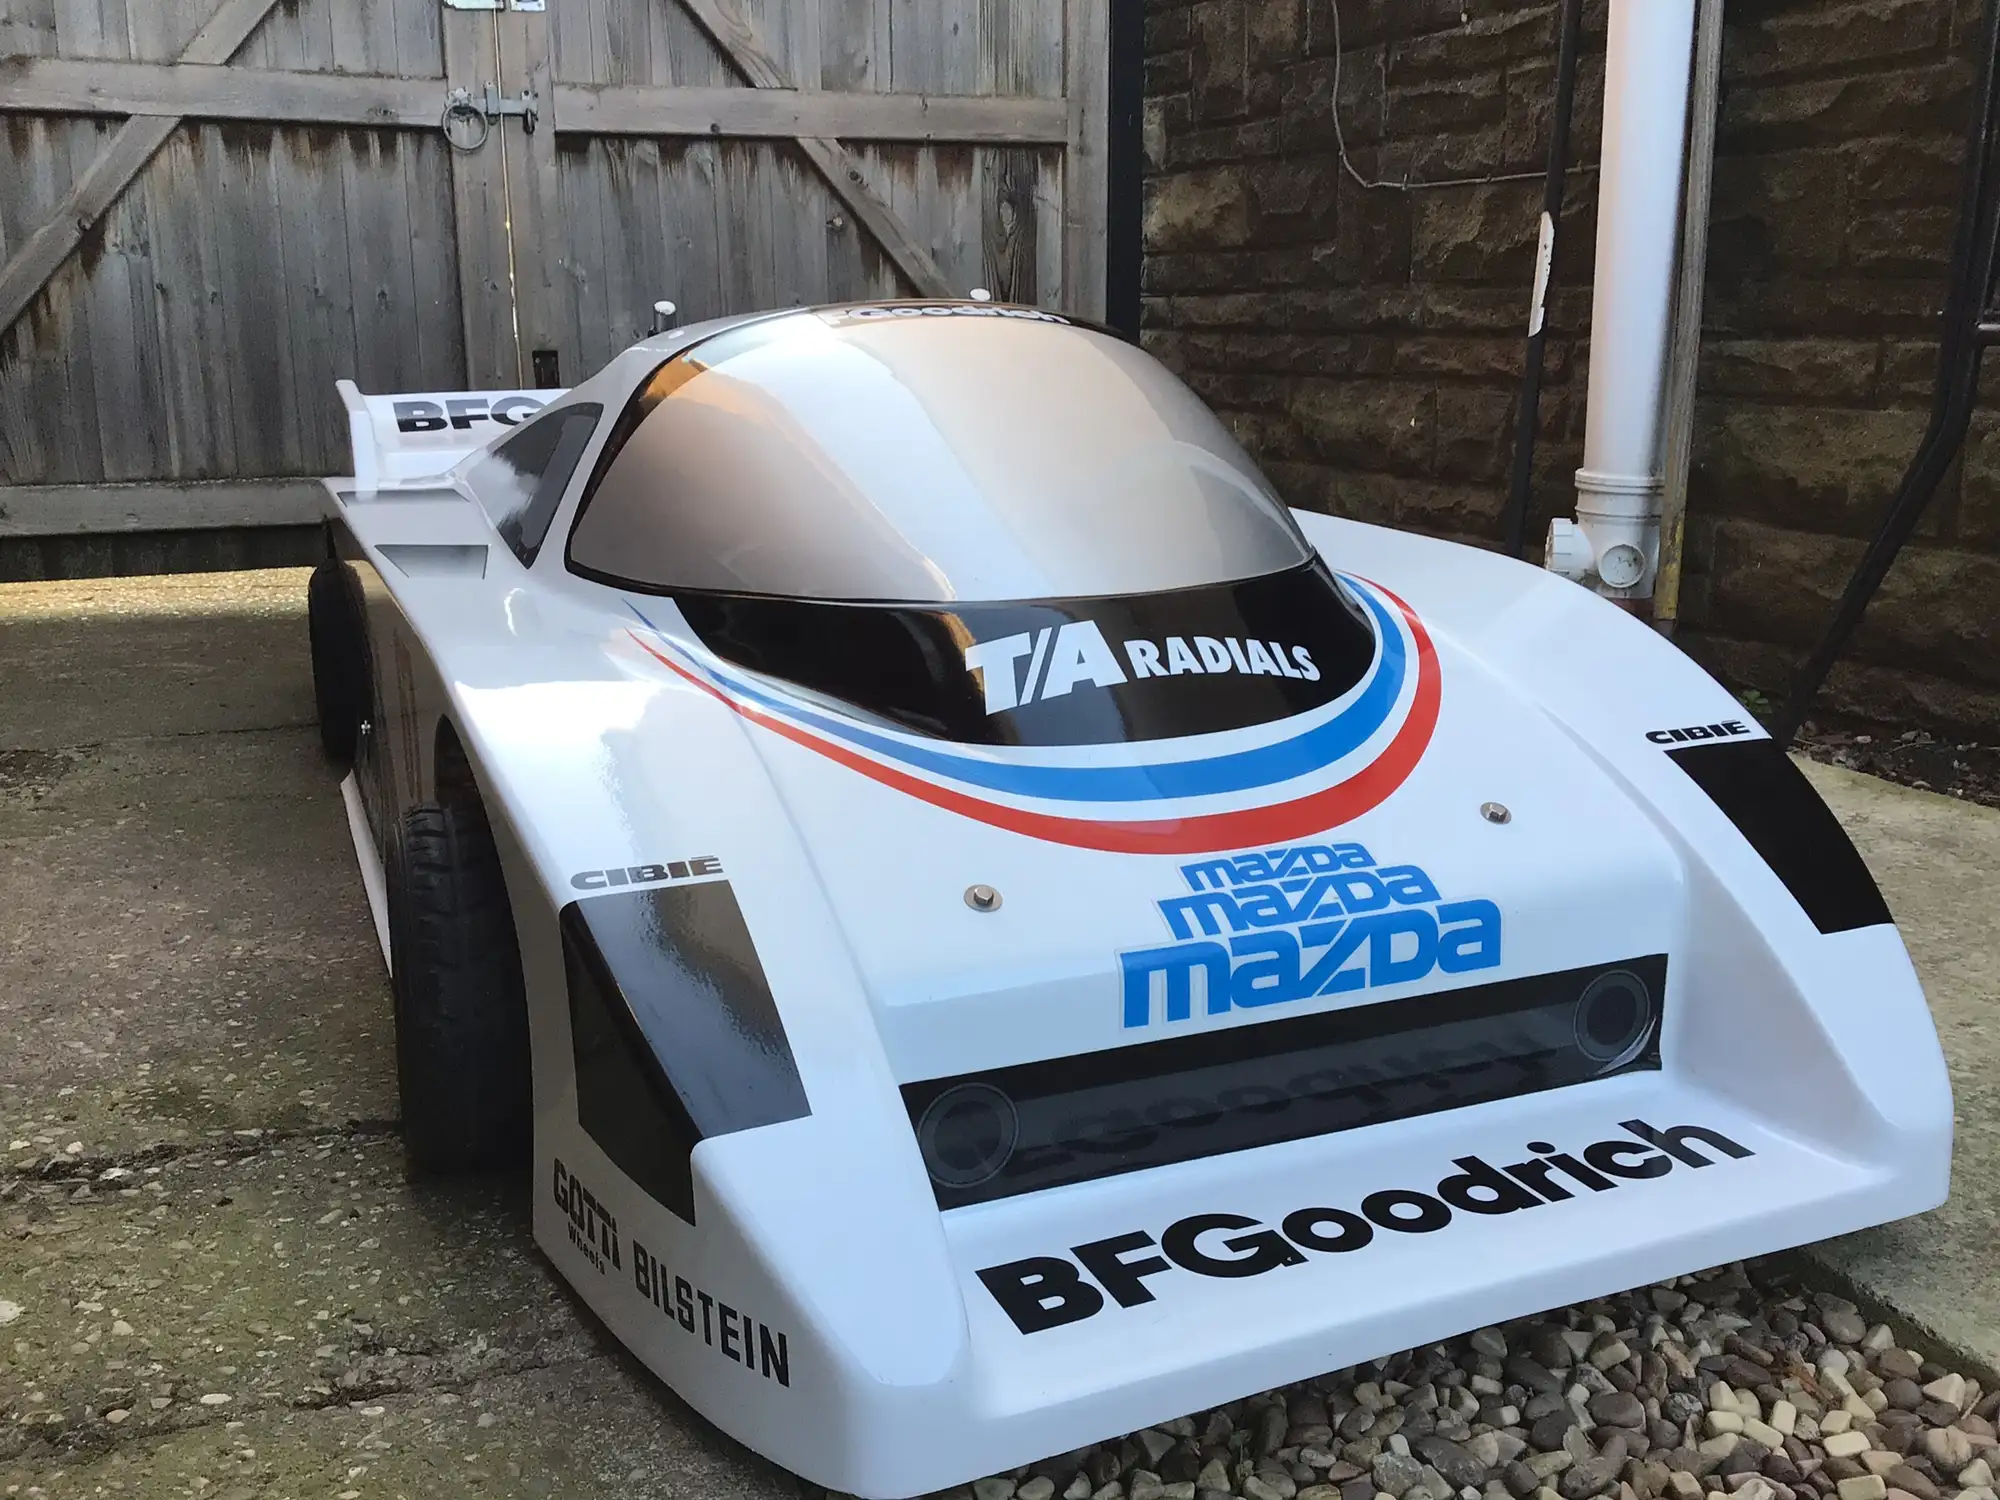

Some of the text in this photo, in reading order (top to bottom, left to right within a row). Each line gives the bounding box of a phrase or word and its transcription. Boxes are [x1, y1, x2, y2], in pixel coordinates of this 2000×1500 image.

[965, 620, 1321, 716] T/A RADIALS
[567, 1221, 605, 1275] Wheels
[975, 1119, 1756, 1335] BFGoodrich
[632, 1239, 790, 1388] BILSTEIN
